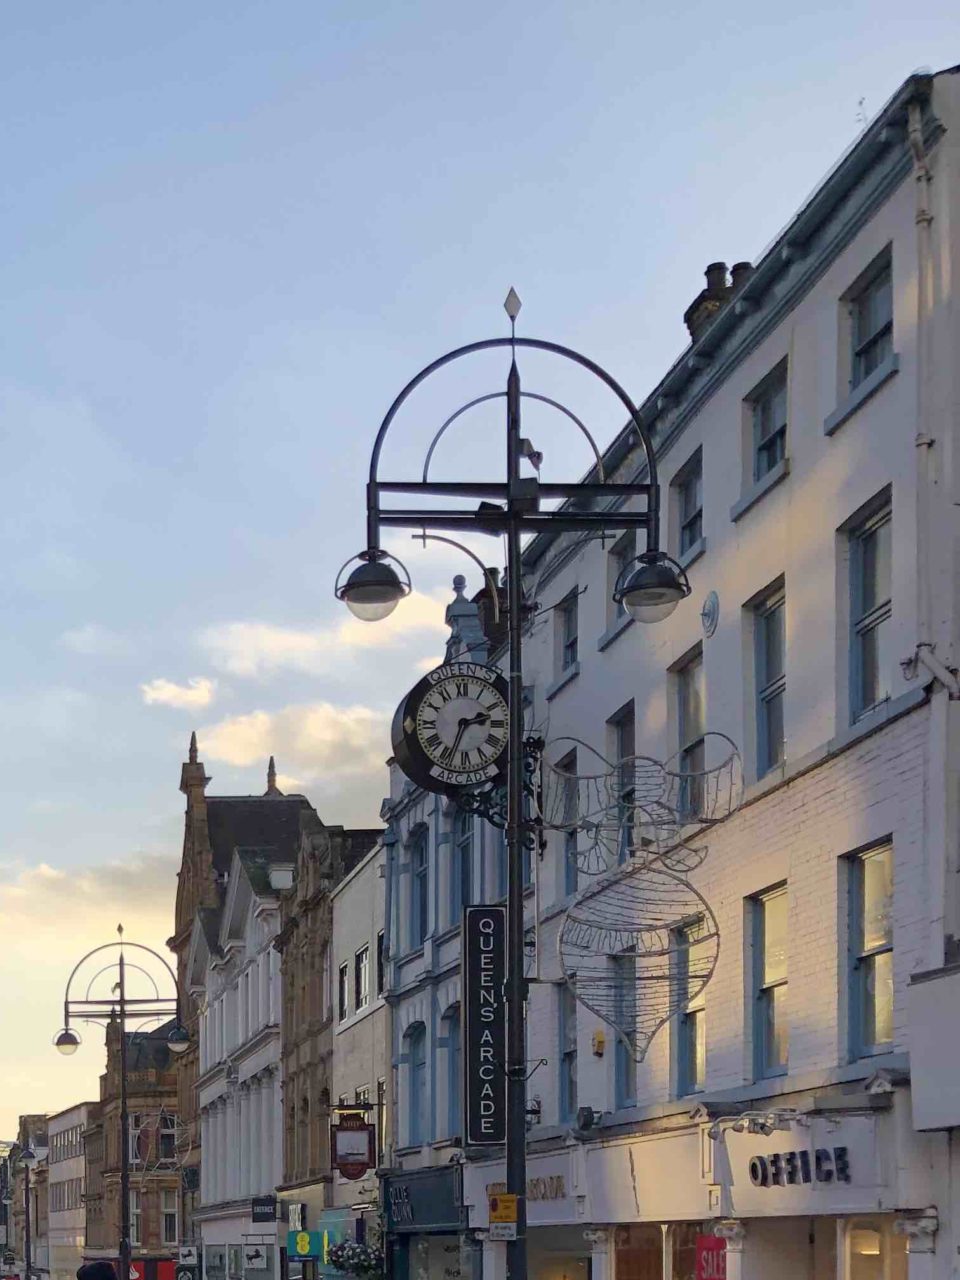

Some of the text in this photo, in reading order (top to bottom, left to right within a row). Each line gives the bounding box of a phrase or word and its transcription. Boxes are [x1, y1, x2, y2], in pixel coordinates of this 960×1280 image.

[430, 664, 492, 682] QUEEN'S
[437, 770, 491, 784] ARCADE
[479, 918, 497, 1133] QUEEN'S ARCADE
[749, 1146, 851, 1187] OFFICE
[701, 1250, 725, 1279] SALE
